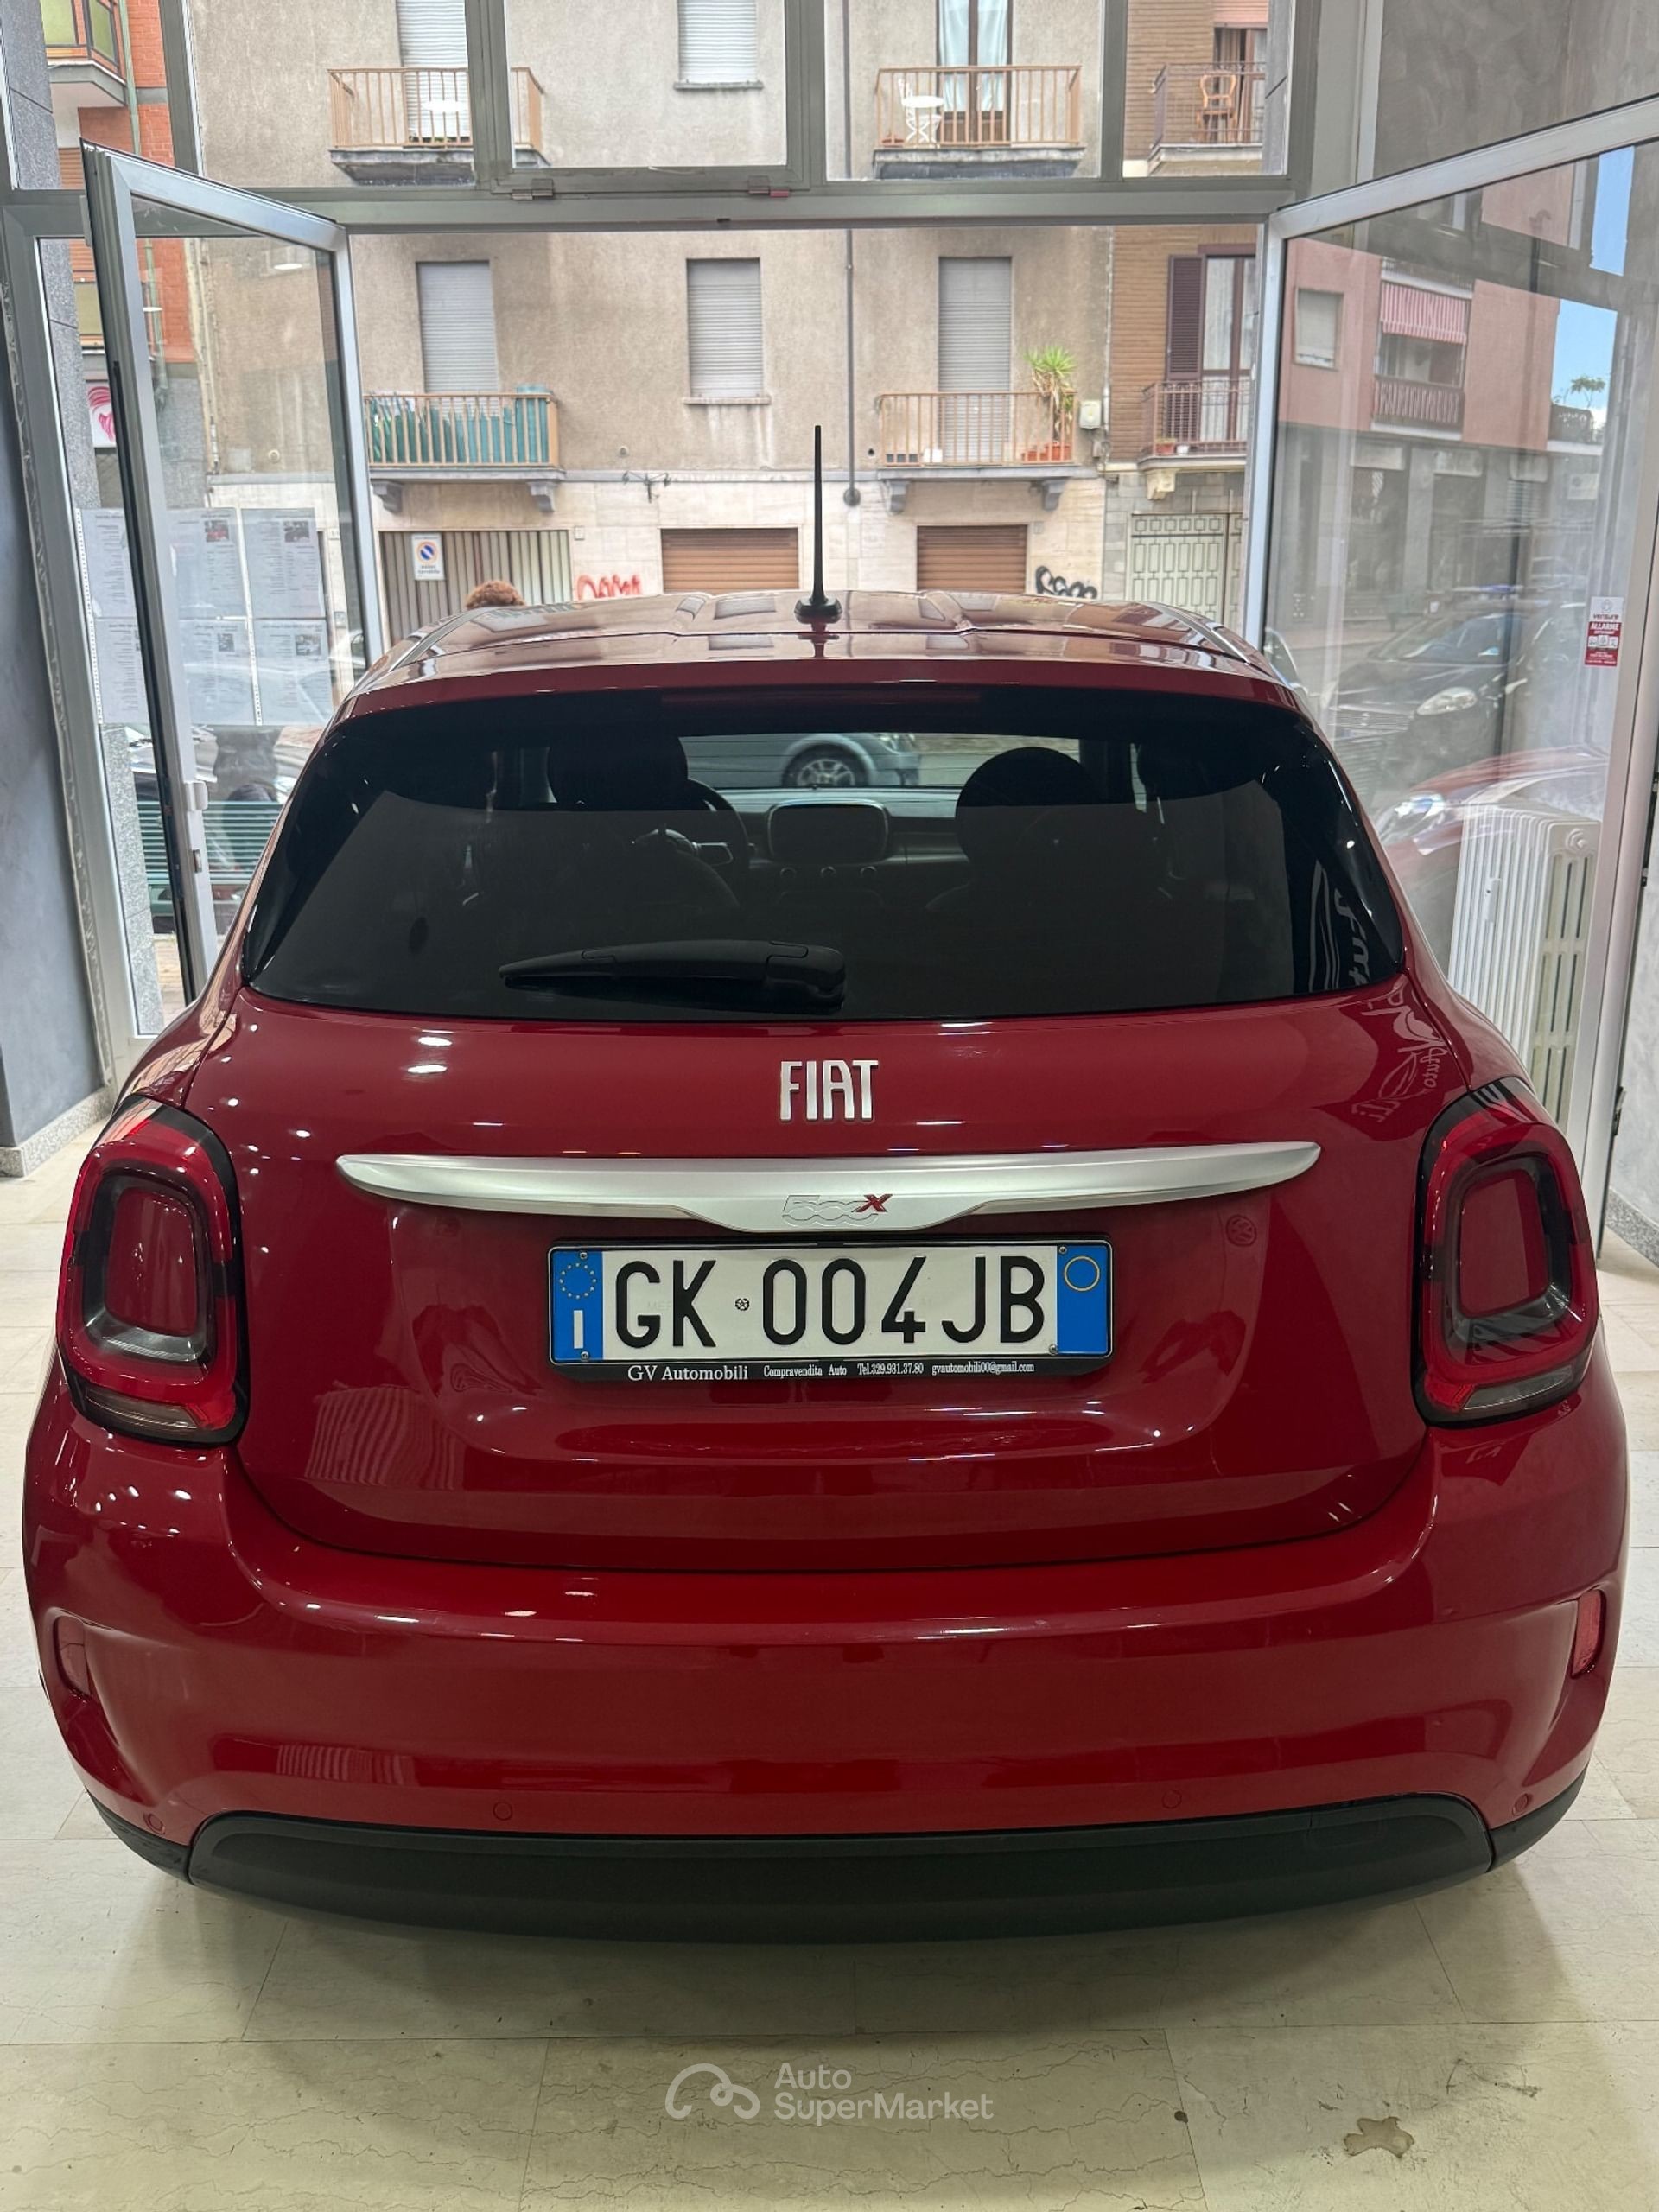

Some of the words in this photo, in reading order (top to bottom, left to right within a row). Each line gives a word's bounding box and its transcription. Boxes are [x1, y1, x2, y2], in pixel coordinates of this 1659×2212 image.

[779, 1059, 880, 1122] FIAT
[573, 1310, 584, 1349] I
[615, 1259, 716, 1349] GK
[627, 1364, 658, 1381] GV
[661, 1364, 748, 1381] Automobili
[763, 1363, 823, 1379] Compravendita
[828, 1363, 848, 1376] Auto
